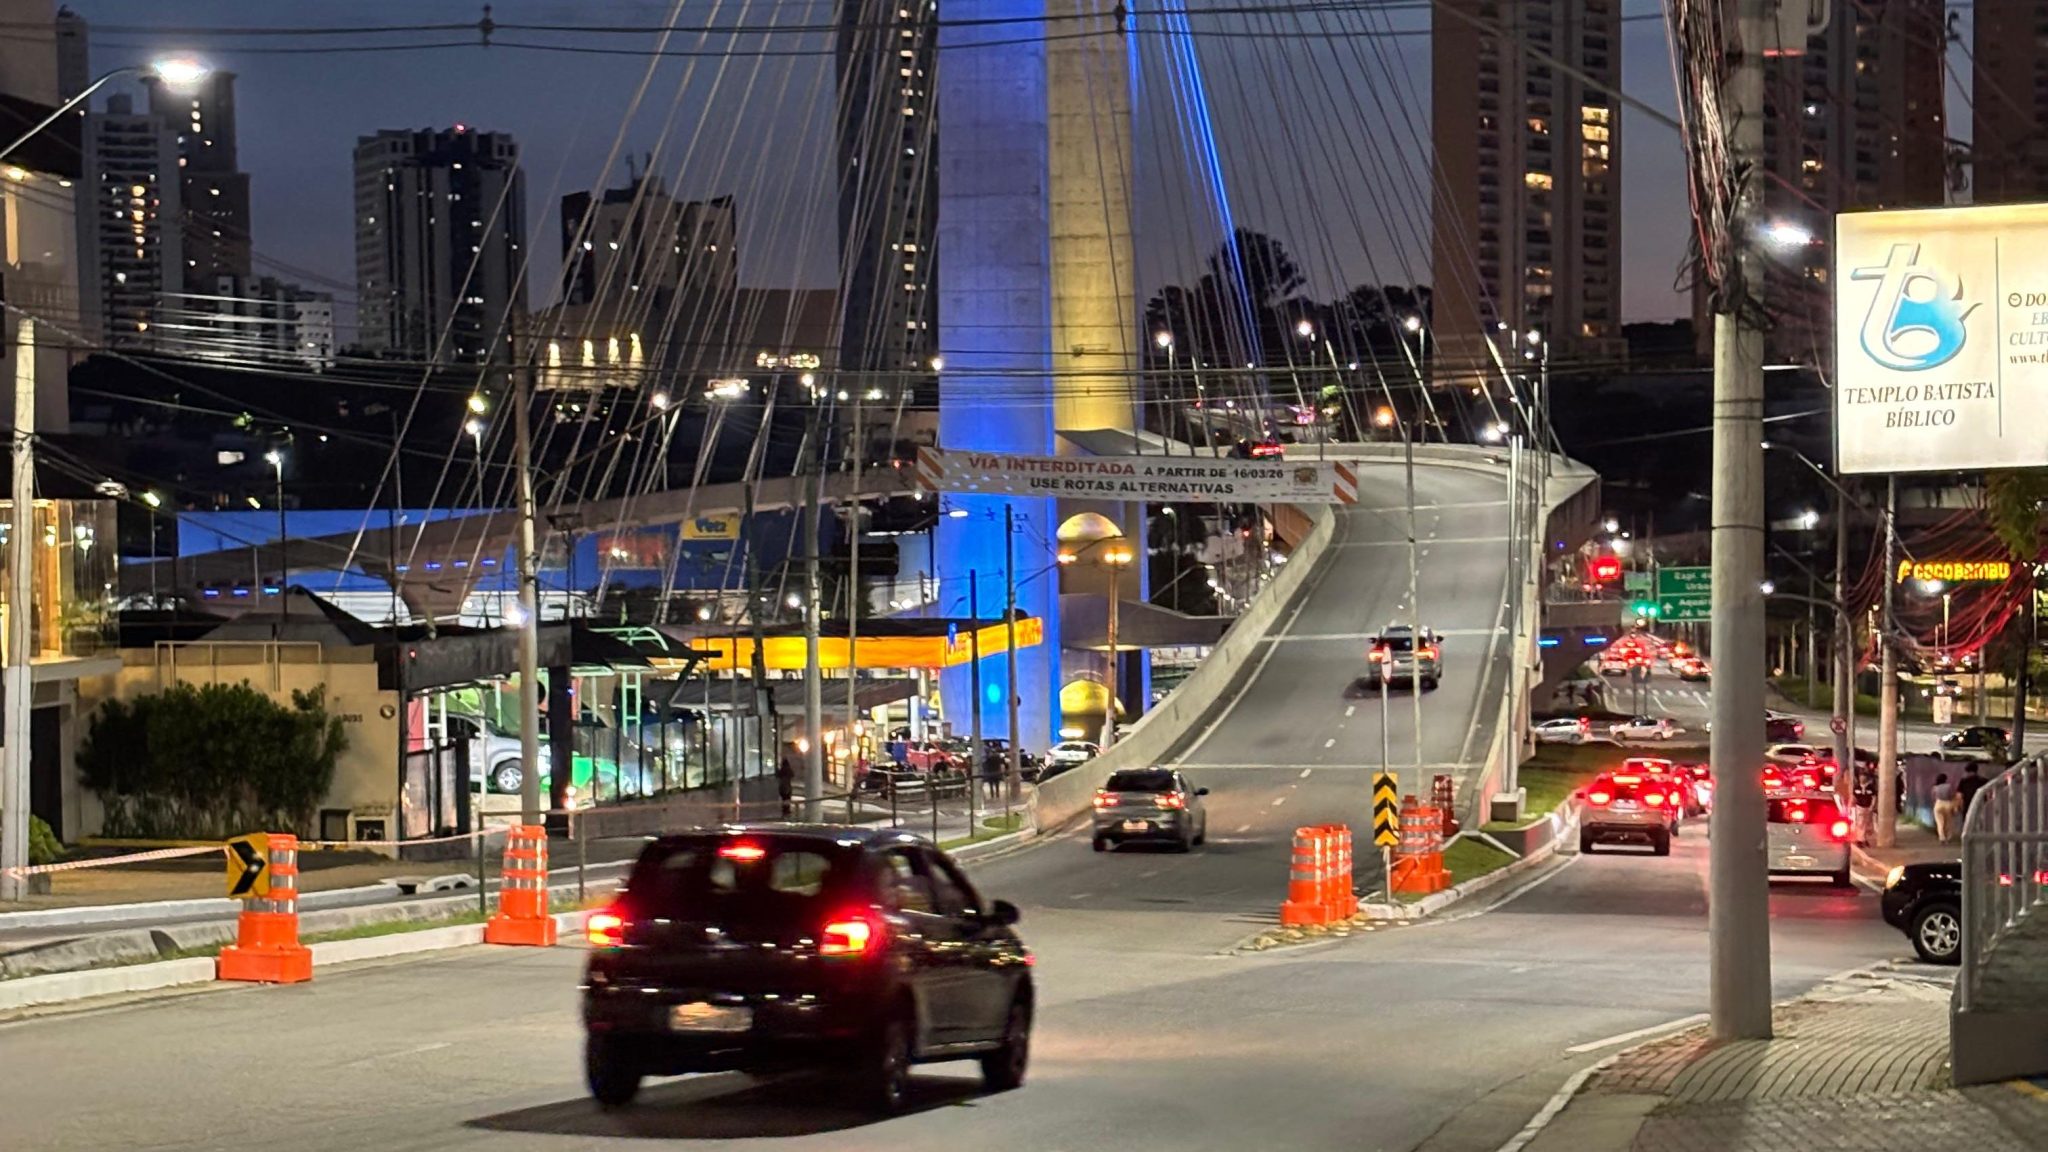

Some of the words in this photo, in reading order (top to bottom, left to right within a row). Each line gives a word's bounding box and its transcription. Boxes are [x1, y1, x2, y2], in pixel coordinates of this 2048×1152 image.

[2025, 293, 2048, 306] DO
[2032, 311, 2048, 325] EB
[2009, 331, 2048, 345] CULT
[1845, 385, 1918, 404] TEMPLO
[1924, 382, 1995, 400] BATISTA
[1886, 407, 1955, 428] BÍBLICO
[968, 457, 1000, 470] VIA
[1007, 457, 1135, 475] INTERDITADA
[1144, 467, 1153, 476] A
[1157, 467, 1206, 478] PARTIR
[1210, 468, 1227, 478] DE
[1234, 468, 1284, 479] 16/03/26
[1030, 477, 1059, 489] USE
[1064, 479, 1114, 491] ROTAS
[1119, 481, 1234, 494] ALTERNATIVAS
